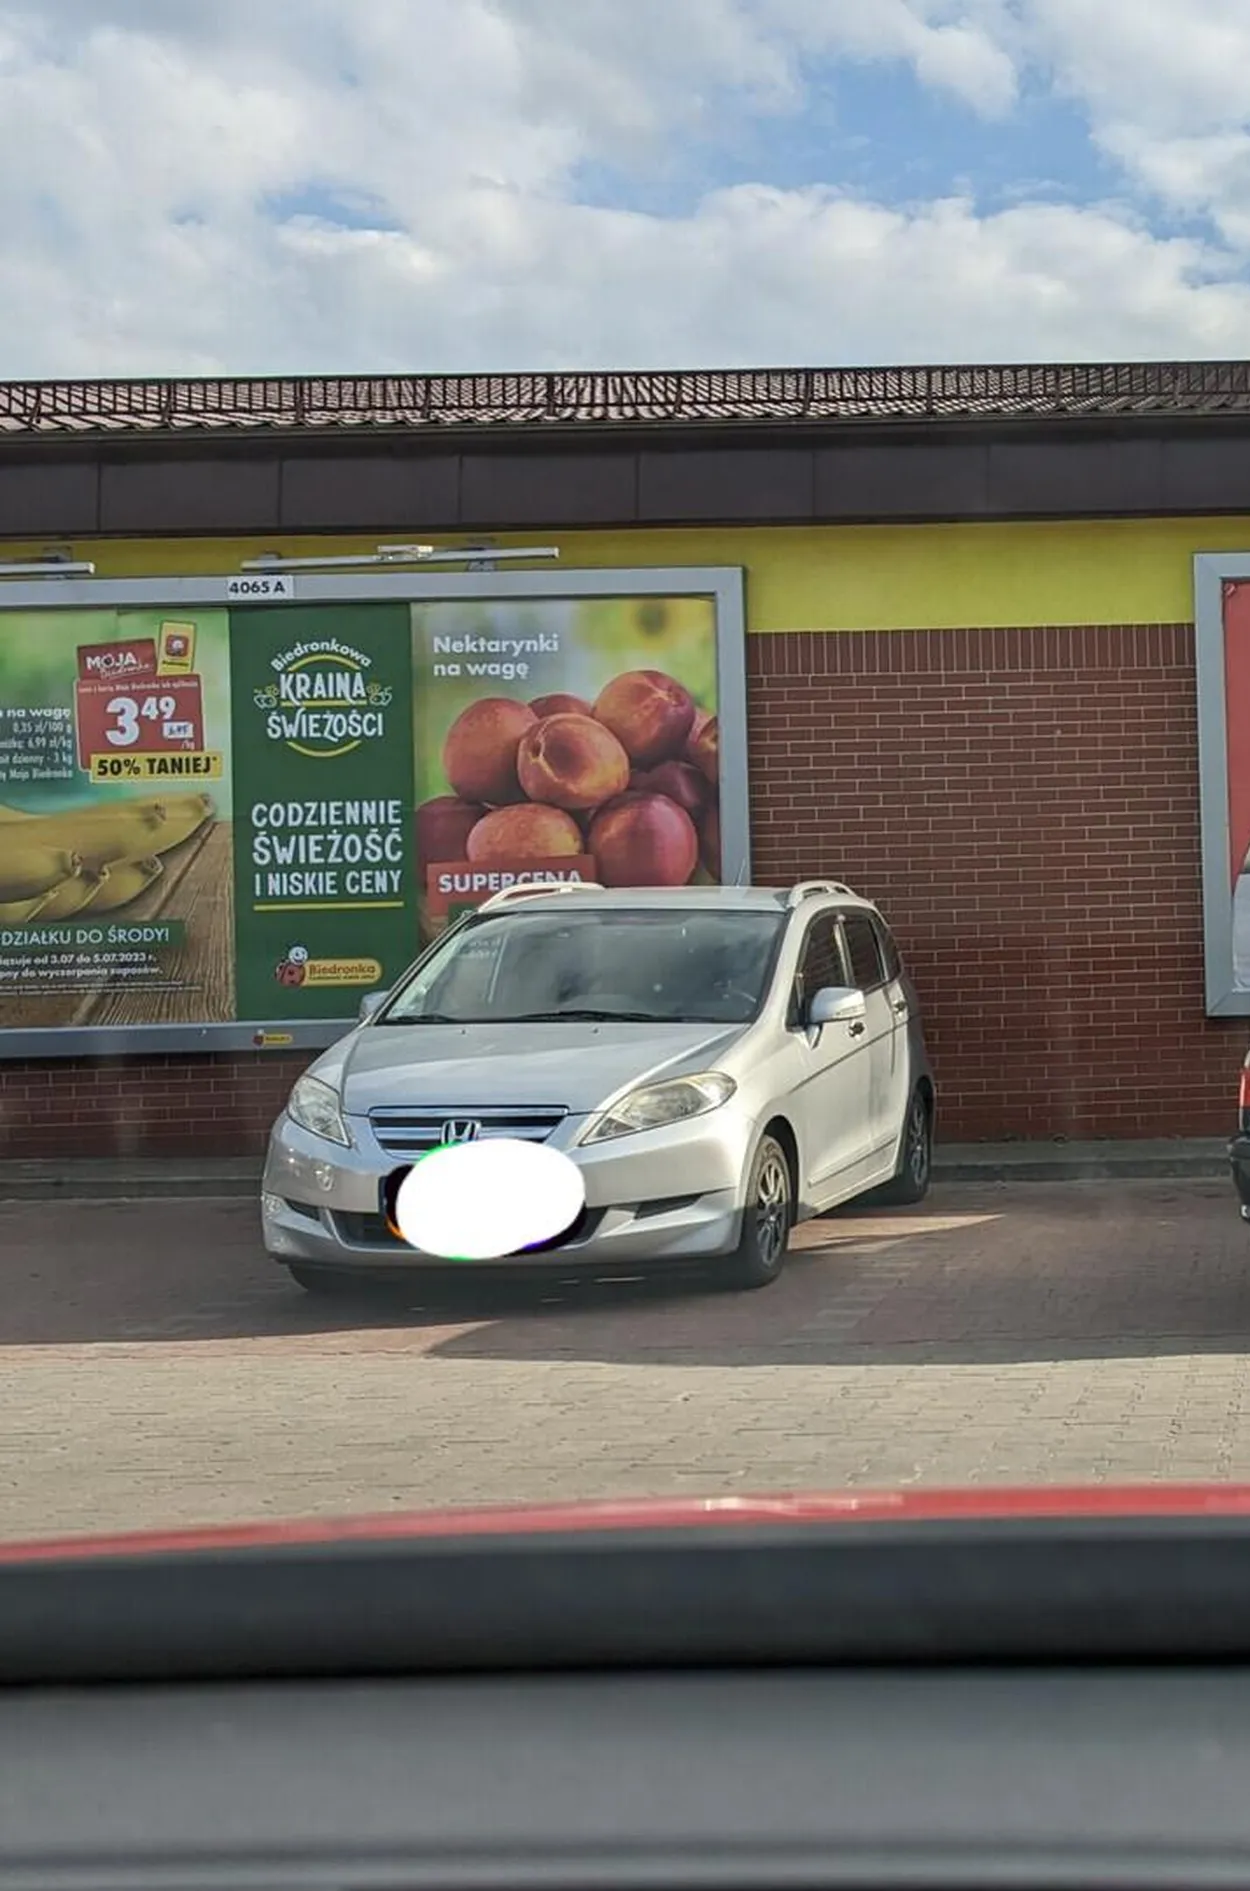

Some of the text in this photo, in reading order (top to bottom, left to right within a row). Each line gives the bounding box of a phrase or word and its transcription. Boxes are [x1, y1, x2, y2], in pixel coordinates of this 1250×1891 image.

[229, 581, 285, 593] 4065 A
[433, 633, 560, 656] Nektarynki
[86, 651, 137, 670] MOJA
[270, 638, 372, 671] Biedronkowa
[433, 661, 529, 679] na wagę
[280, 672, 366, 705] KRAINA
[7, 708, 26, 718] na
[267, 707, 384, 742] ŚWIEŻOŚCI
[97, 759, 141, 776] 50%
[251, 801, 402, 827] CODZIENNIE
[252, 828, 403, 865] ŚWIEŻOŚĆ
[268, 871, 338, 895] NISKIE
[346, 869, 402, 894] CENY
[1, 930, 71, 946] DZIAŁKU
[76, 929, 103, 944] DO
[50, 953, 74, 964] 3.07
[76, 953, 91, 964] do
[93, 952, 146, 963] 5.07.2023
[309, 963, 376, 976] Biedronka
